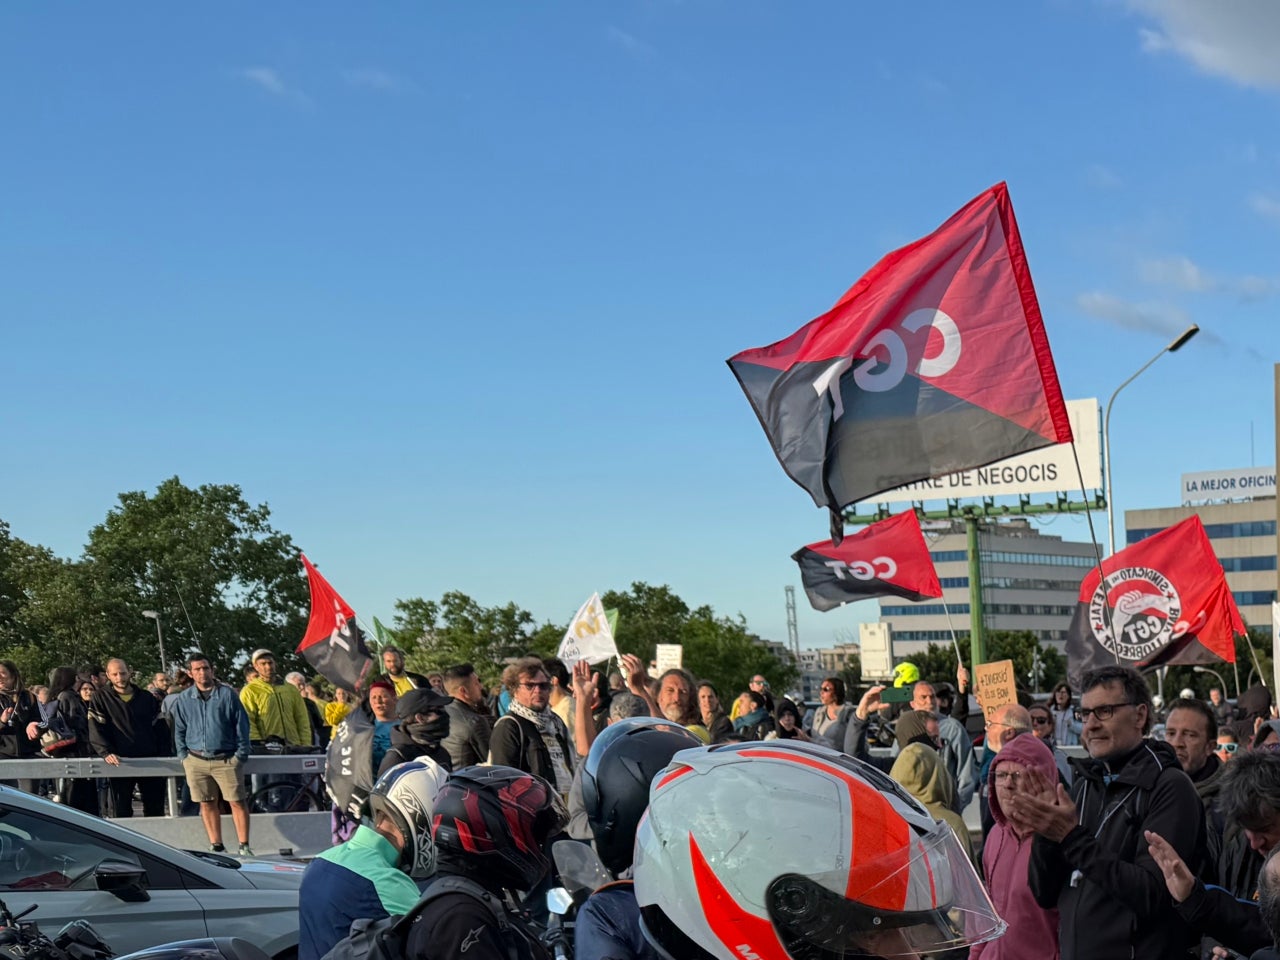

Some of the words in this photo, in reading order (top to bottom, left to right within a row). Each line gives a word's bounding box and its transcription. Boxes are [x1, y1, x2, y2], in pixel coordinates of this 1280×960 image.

[949, 469, 972, 487] DE
[977, 463, 1058, 485] NEGOCIS
[1186, 480, 1198, 492] LA
[1200, 478, 1236, 491] MEJOR
